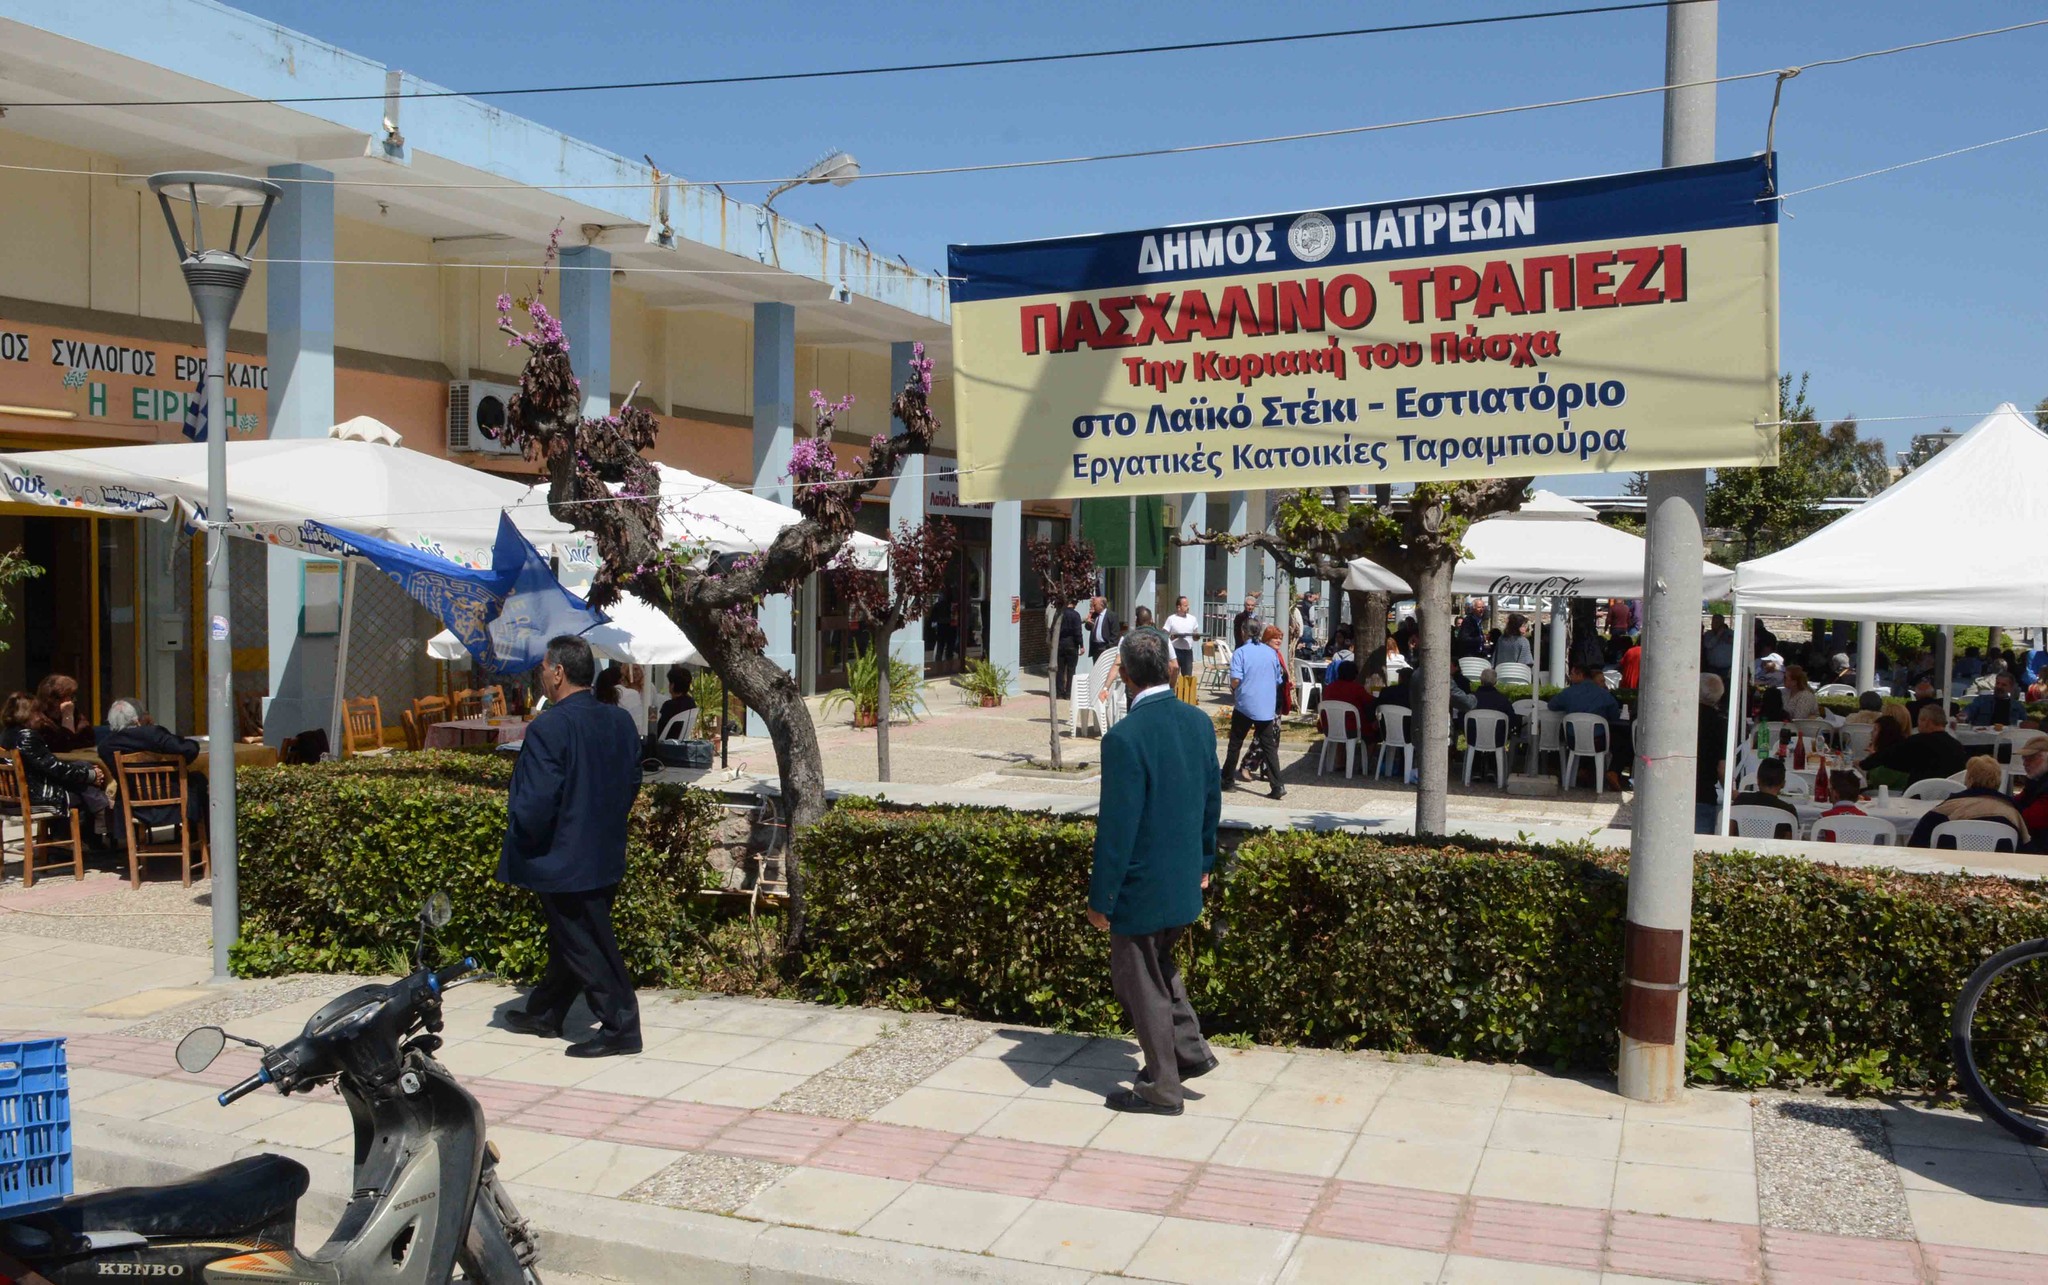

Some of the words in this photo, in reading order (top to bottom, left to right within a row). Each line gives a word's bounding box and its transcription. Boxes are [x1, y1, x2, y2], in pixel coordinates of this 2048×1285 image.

[1138, 223, 1276, 274] ΔΗΜΟΣ
[1346, 194, 1535, 252] ΠΑΤΡΕΩΝ
[1020, 273, 1377, 355] ΠΑΣΧΑΛΙΝΟ
[1389, 244, 1687, 324] ΤΡΑΠΕΖΙ
[52, 339, 156, 376] ΣΥΛΛΟΓΟΣ
[1122, 356, 1187, 392] Την
[1193, 335, 1346, 387] Κυριακή
[1352, 341, 1422, 370] του
[1430, 324, 1561, 368] Πάσχα
[89, 382, 107, 416] Η
[133, 387, 237, 427] ΕΙΡΗΗ
[1072, 411, 1138, 439] στο
[1145, 393, 1253, 434] Λαϊκό
[1262, 388, 1359, 428] Στέκι
[1396, 372, 1626, 419] Εστιατόριο
[1072, 442, 1224, 485] Εργατικές
[1232, 434, 1389, 471] Κατοικίες
[1396, 421, 1627, 468] Ταραμπούρα
[392, 1191, 436, 1211] KENBO
[98, 1263, 184, 1277] KENBO
